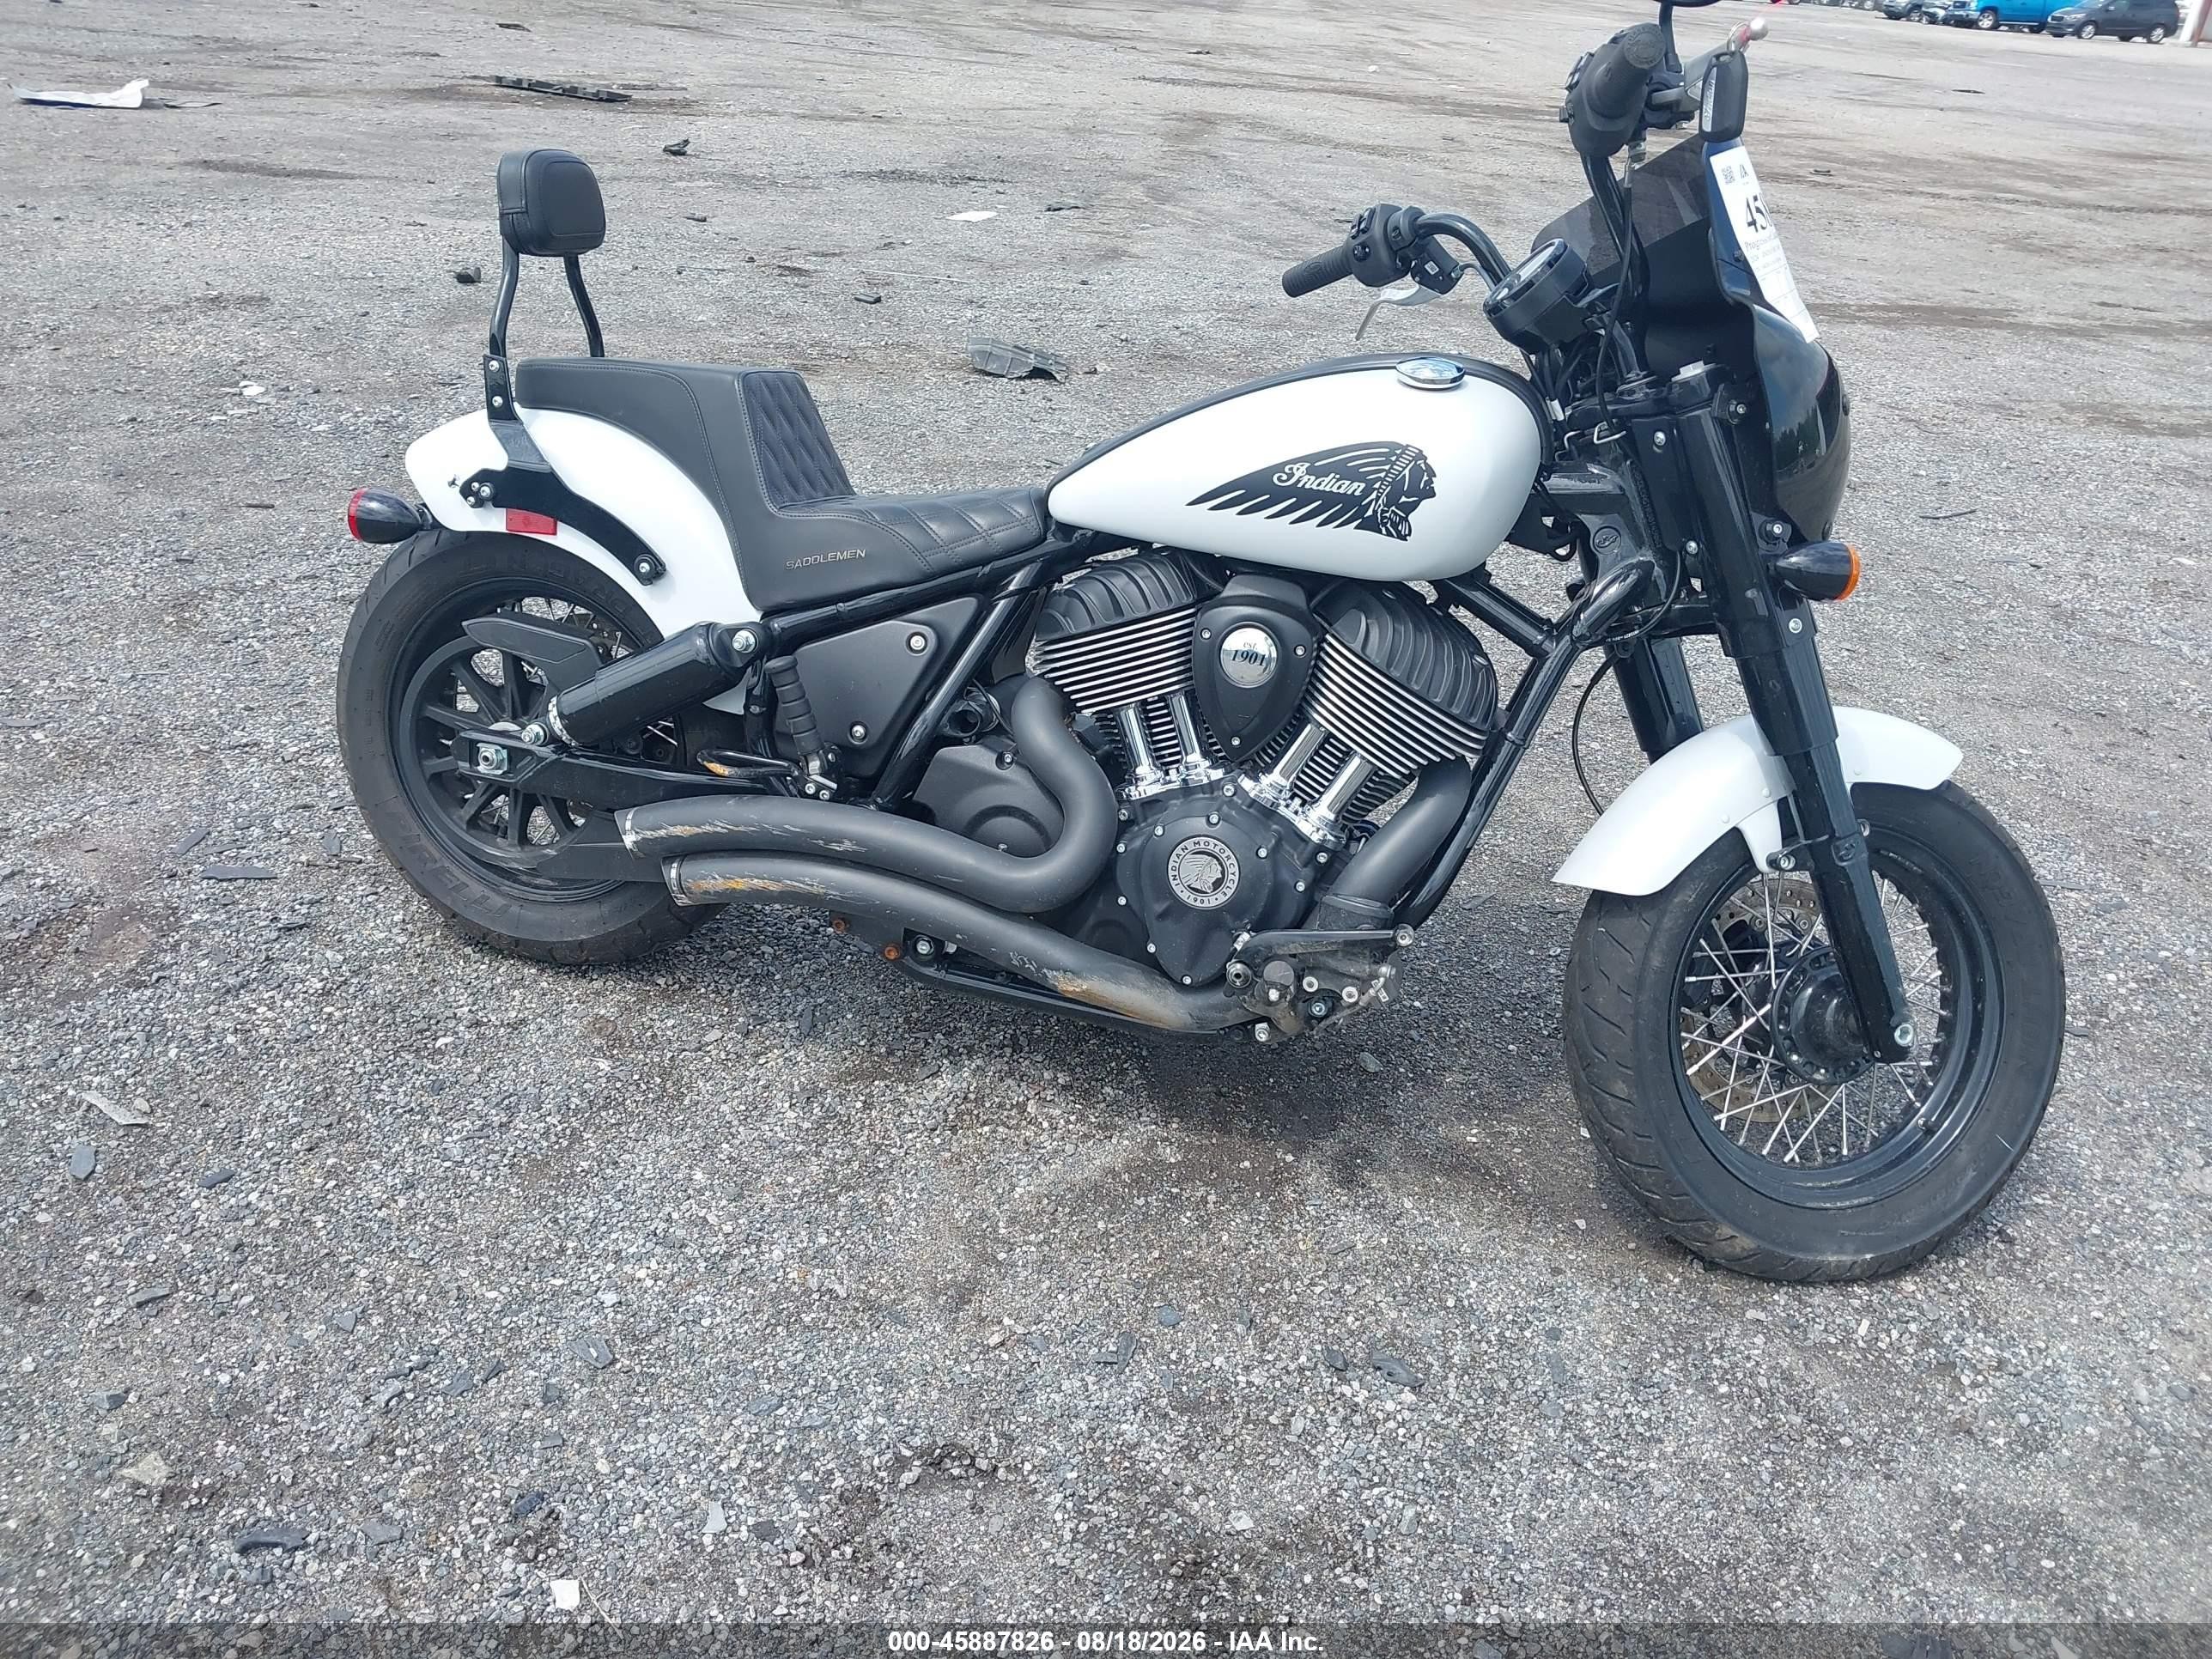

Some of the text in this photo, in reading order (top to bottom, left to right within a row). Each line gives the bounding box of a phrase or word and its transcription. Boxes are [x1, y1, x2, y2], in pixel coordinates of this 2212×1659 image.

[1272, 462, 1366, 496] Indian
[785, 549, 866, 571] SADDLEMEN
[1231, 649, 1267, 666] 1901
[1170, 841, 1236, 898] INDIAN MOTORCYCLE
[1186, 896, 1211, 905] 1901
